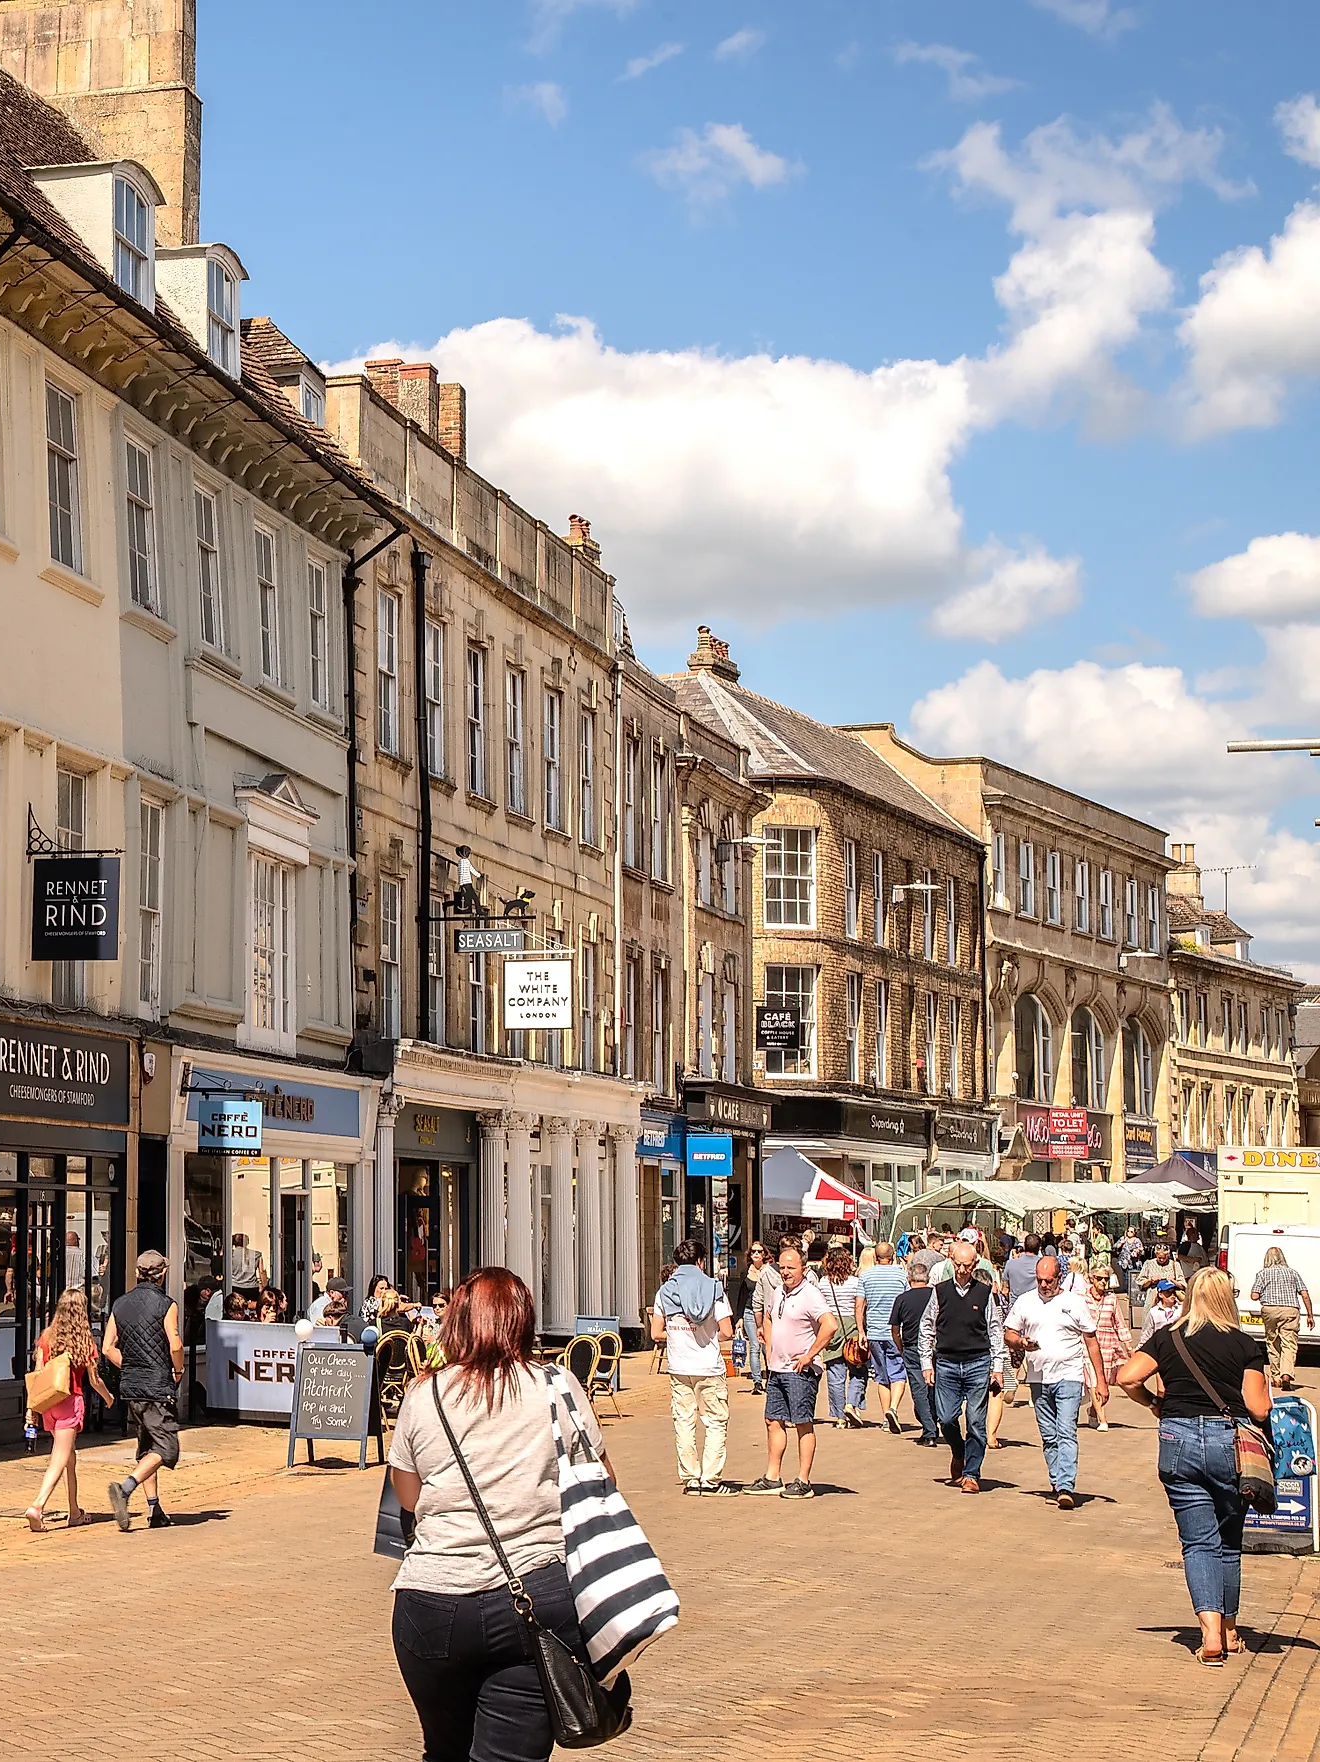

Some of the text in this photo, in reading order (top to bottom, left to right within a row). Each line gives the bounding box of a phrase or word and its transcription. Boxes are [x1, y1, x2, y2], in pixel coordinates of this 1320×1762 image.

[46, 879, 108, 896] RENNET
[72, 895, 79, 904] &
[45, 903, 107, 927] RIND
[458, 932, 520, 949] SEASALT
[526, 971, 550, 981] THE
[518, 984, 558, 994] WHITE
[508, 996, 569, 1007] COMPANY
[763, 1011, 792, 1021] CAFÉ
[760, 1020, 796, 1029] BLACK
[61, 1047, 74, 1081] &
[75, 1049, 111, 1086] RIND
[9, 1083, 96, 1107] CHEESEMONGERS OF STAMFORD
[283, 1094, 315, 1122] NERO
[723, 1100, 739, 1121] CAFÉ
[211, 1111, 249, 1122] CAFFÈ
[1051, 1119, 1084, 1128] TO LET
[201, 1124, 258, 1138] NERO
[870, 1114, 900, 1135] Superdrug
[692, 1152, 727, 1161] BETFRED
[1242, 1150, 1320, 1168] DINE
[833, 1225, 847, 1234] £30
[253, 1347, 296, 1359] CAFFÈ
[307, 1352, 357, 1367] Our Cheese
[227, 1359, 296, 1384] NER
[309, 1366, 318, 1376] of
[320, 1367, 334, 1376] the
[336, 1368, 353, 1382] day
[319, 1401, 327, 1412] in
[329, 1401, 346, 1414] and
[310, 1414, 322, 1430] Try
